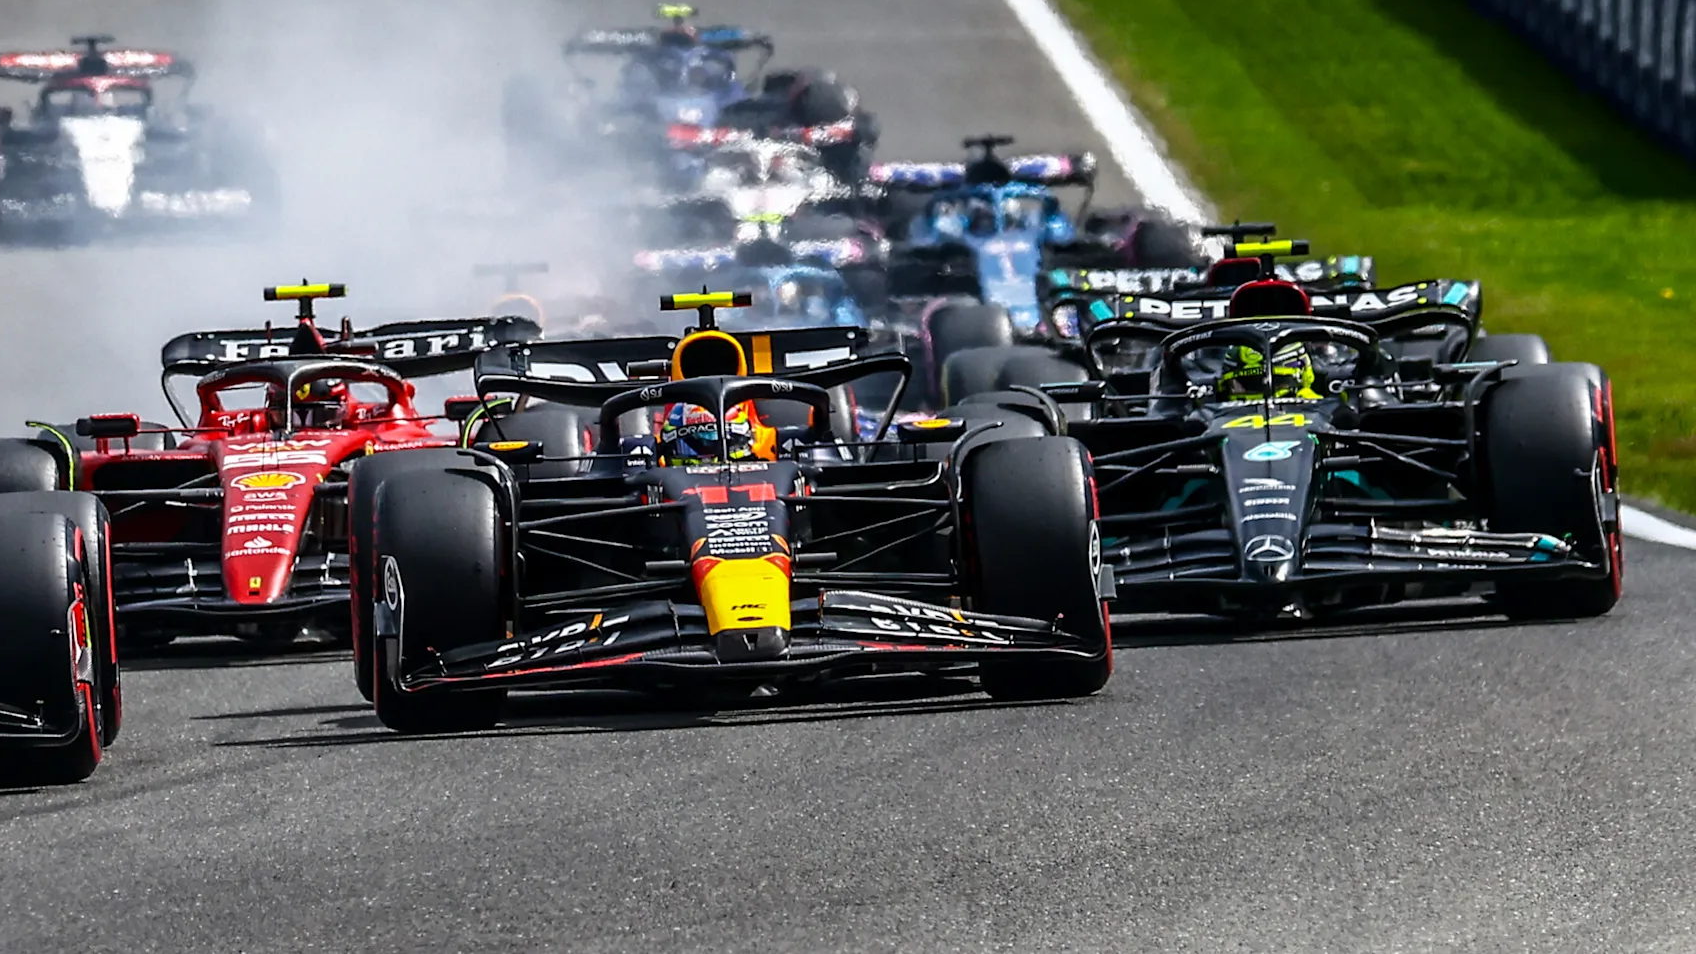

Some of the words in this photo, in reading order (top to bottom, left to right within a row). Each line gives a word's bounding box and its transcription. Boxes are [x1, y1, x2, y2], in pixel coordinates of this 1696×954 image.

[1138, 285, 1418, 319] PETNAS
[1221, 413, 1313, 429] 44
[223, 450, 327, 470] 55
[682, 483, 777, 504] 11
[227, 524, 295, 535] MAHLE
[224, 547, 291, 560] Santander
